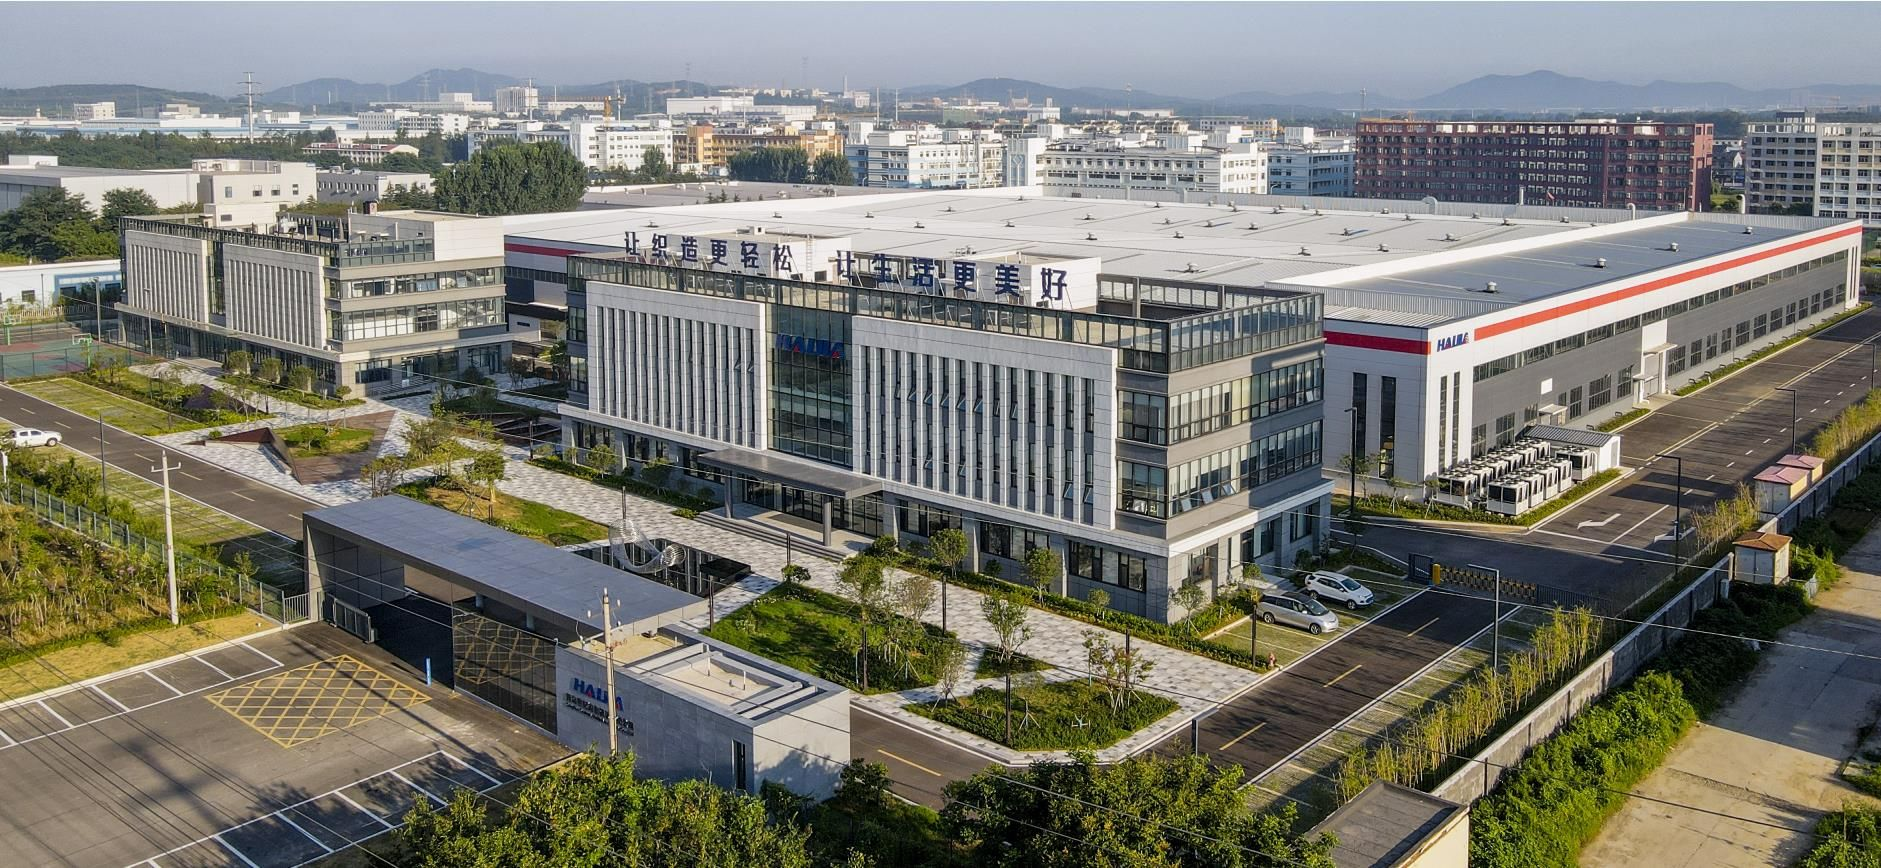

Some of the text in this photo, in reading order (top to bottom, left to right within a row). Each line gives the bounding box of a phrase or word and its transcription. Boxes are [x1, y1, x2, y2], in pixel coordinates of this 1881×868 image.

[624, 231, 1067, 301] 让织造更轻松 让生活更美好
